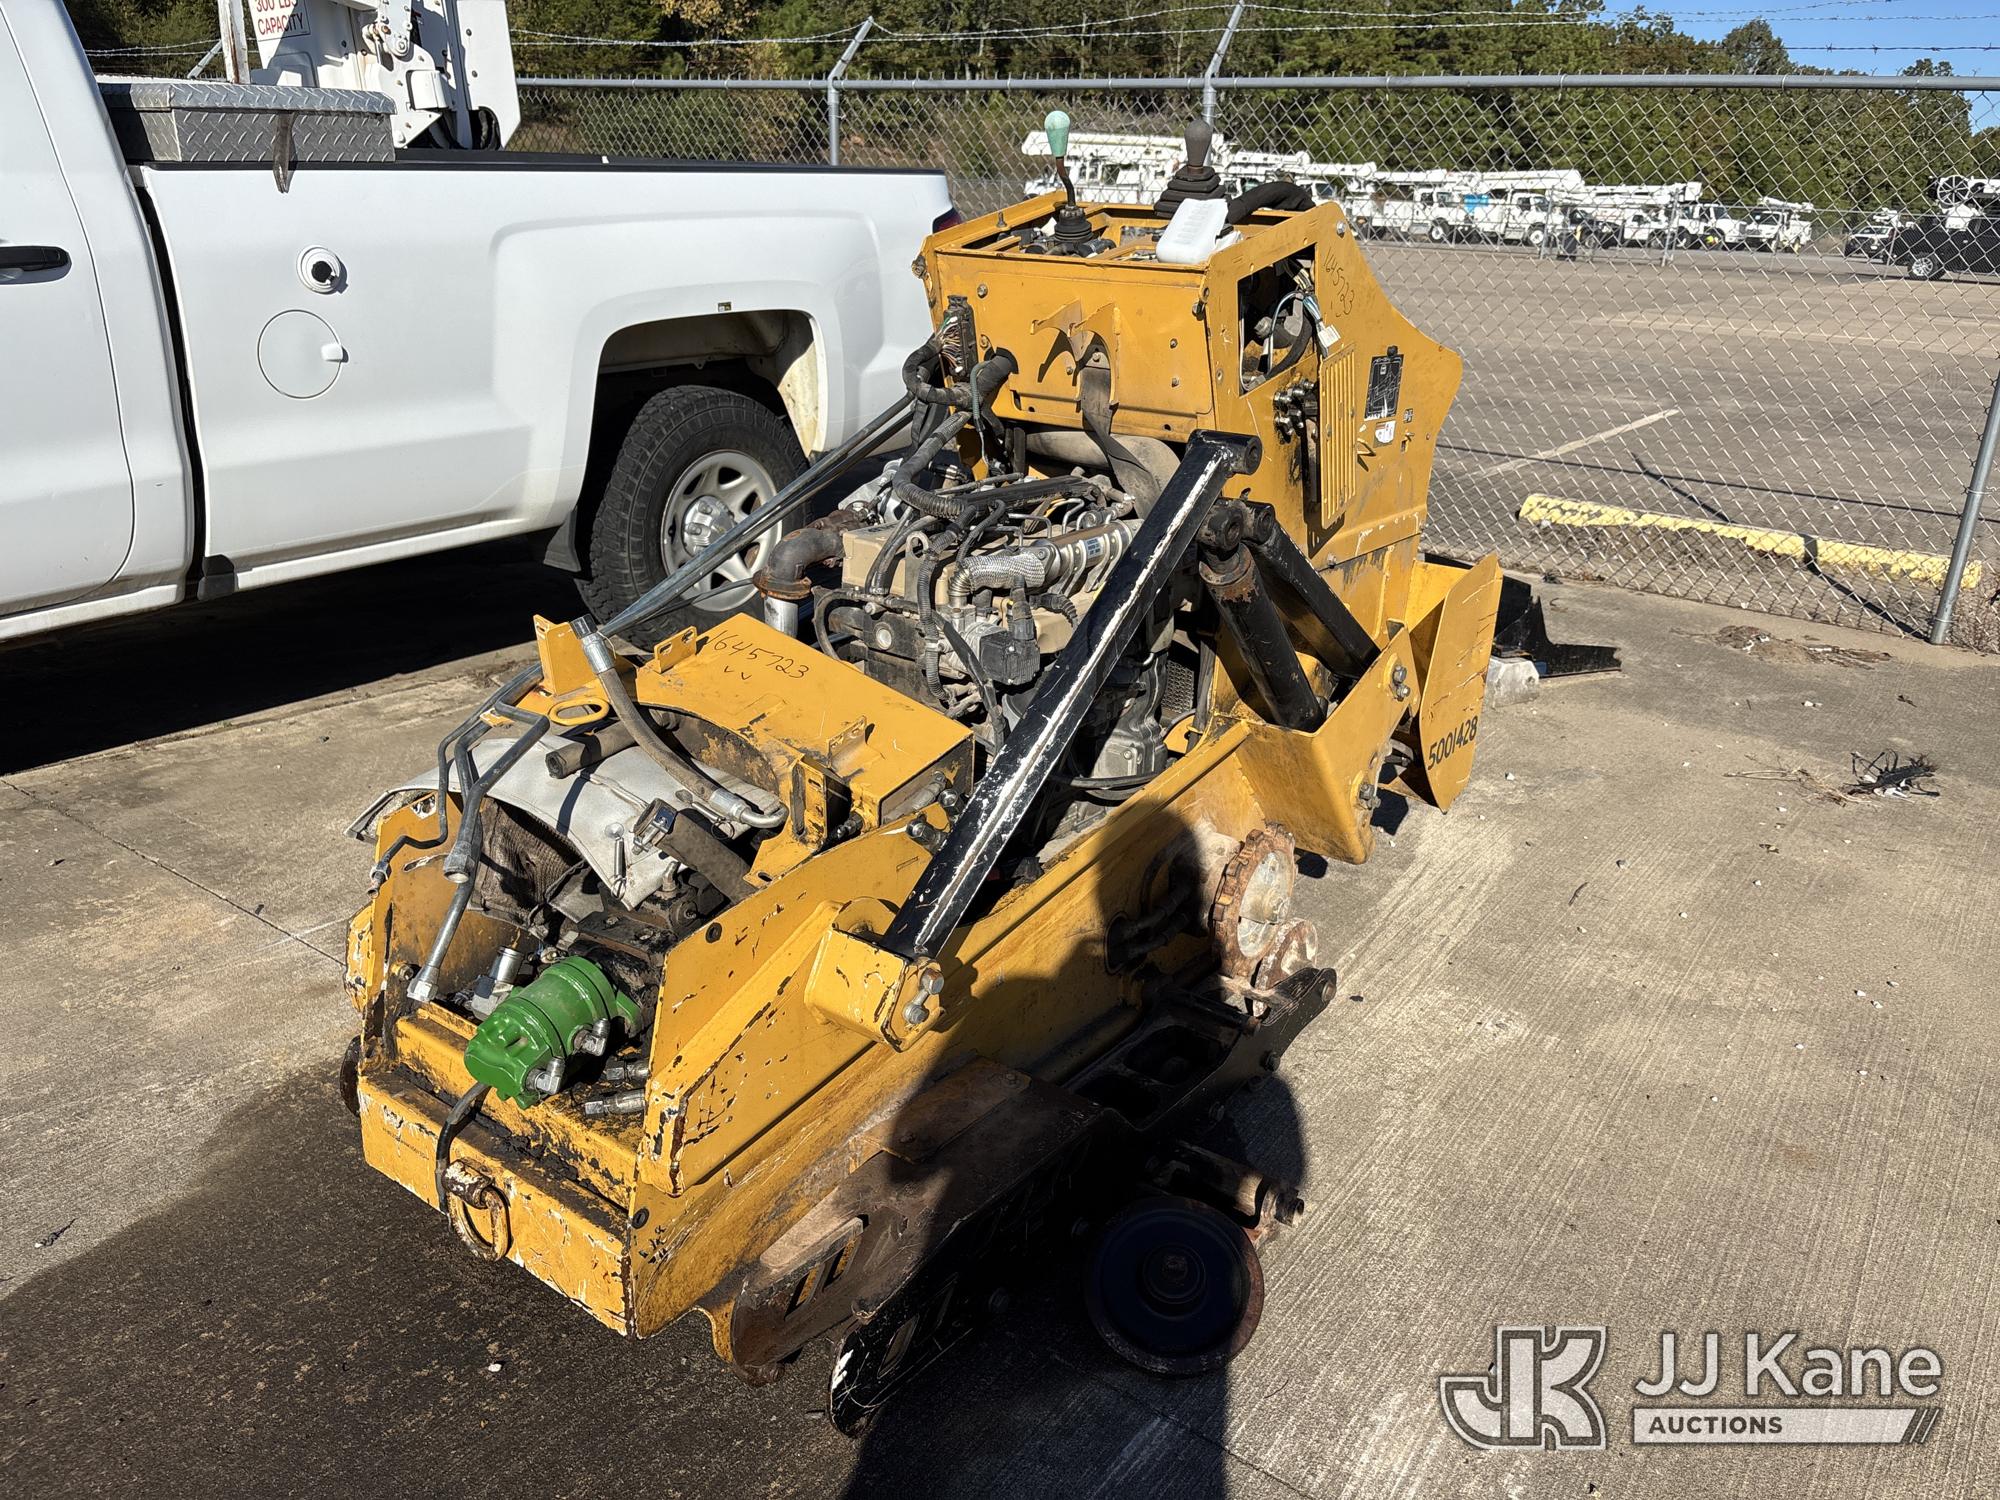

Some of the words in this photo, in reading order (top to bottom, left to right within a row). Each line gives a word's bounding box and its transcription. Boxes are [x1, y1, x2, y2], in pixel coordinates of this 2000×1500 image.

[258, 12, 304, 35] CAPACITY
[707, 630, 809, 679] 1645723
[1427, 715, 1479, 770] 5001428
